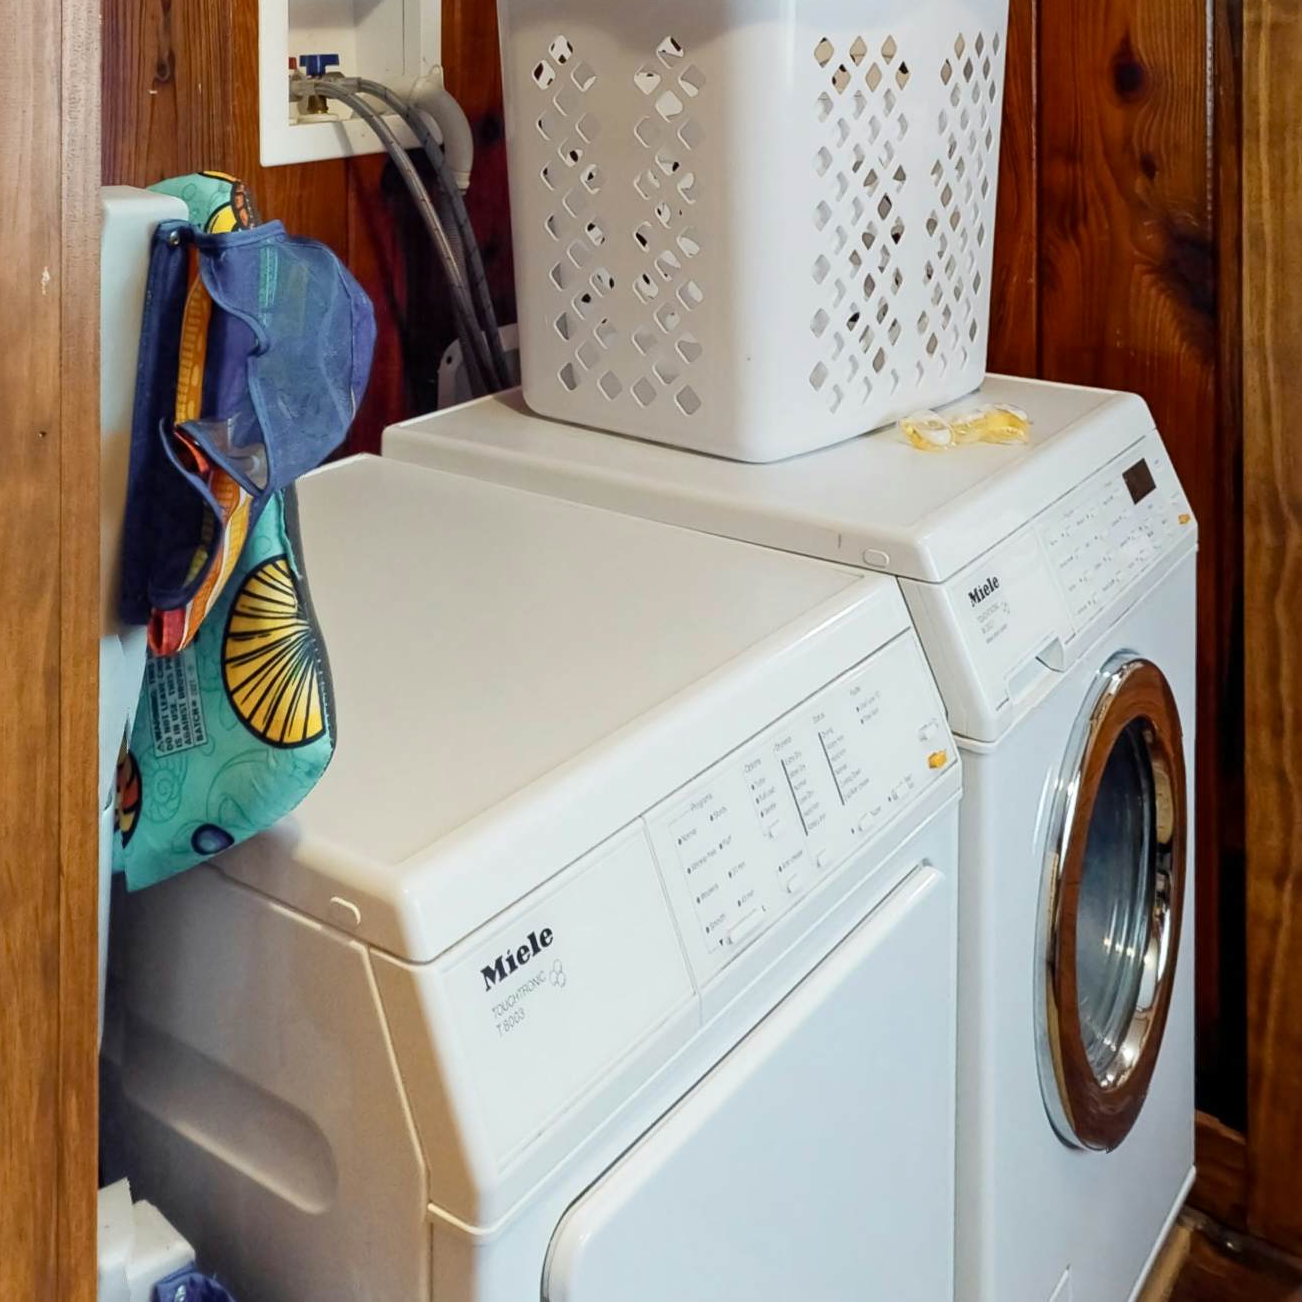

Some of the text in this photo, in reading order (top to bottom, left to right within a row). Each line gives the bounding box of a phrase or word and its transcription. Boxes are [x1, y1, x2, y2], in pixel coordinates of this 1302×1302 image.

[968, 576, 1000, 608] Miele
[158, 683, 167, 711] LEAVE
[162, 715, 171, 733] NOT
[172, 724, 180, 734] IN
[179, 703, 192, 745] AGAINST
[165, 737, 174, 751] DO
[175, 738, 182, 748] IS
[480, 927, 554, 992] Miele
[491, 970, 547, 1019] TOUCHTRONIC
